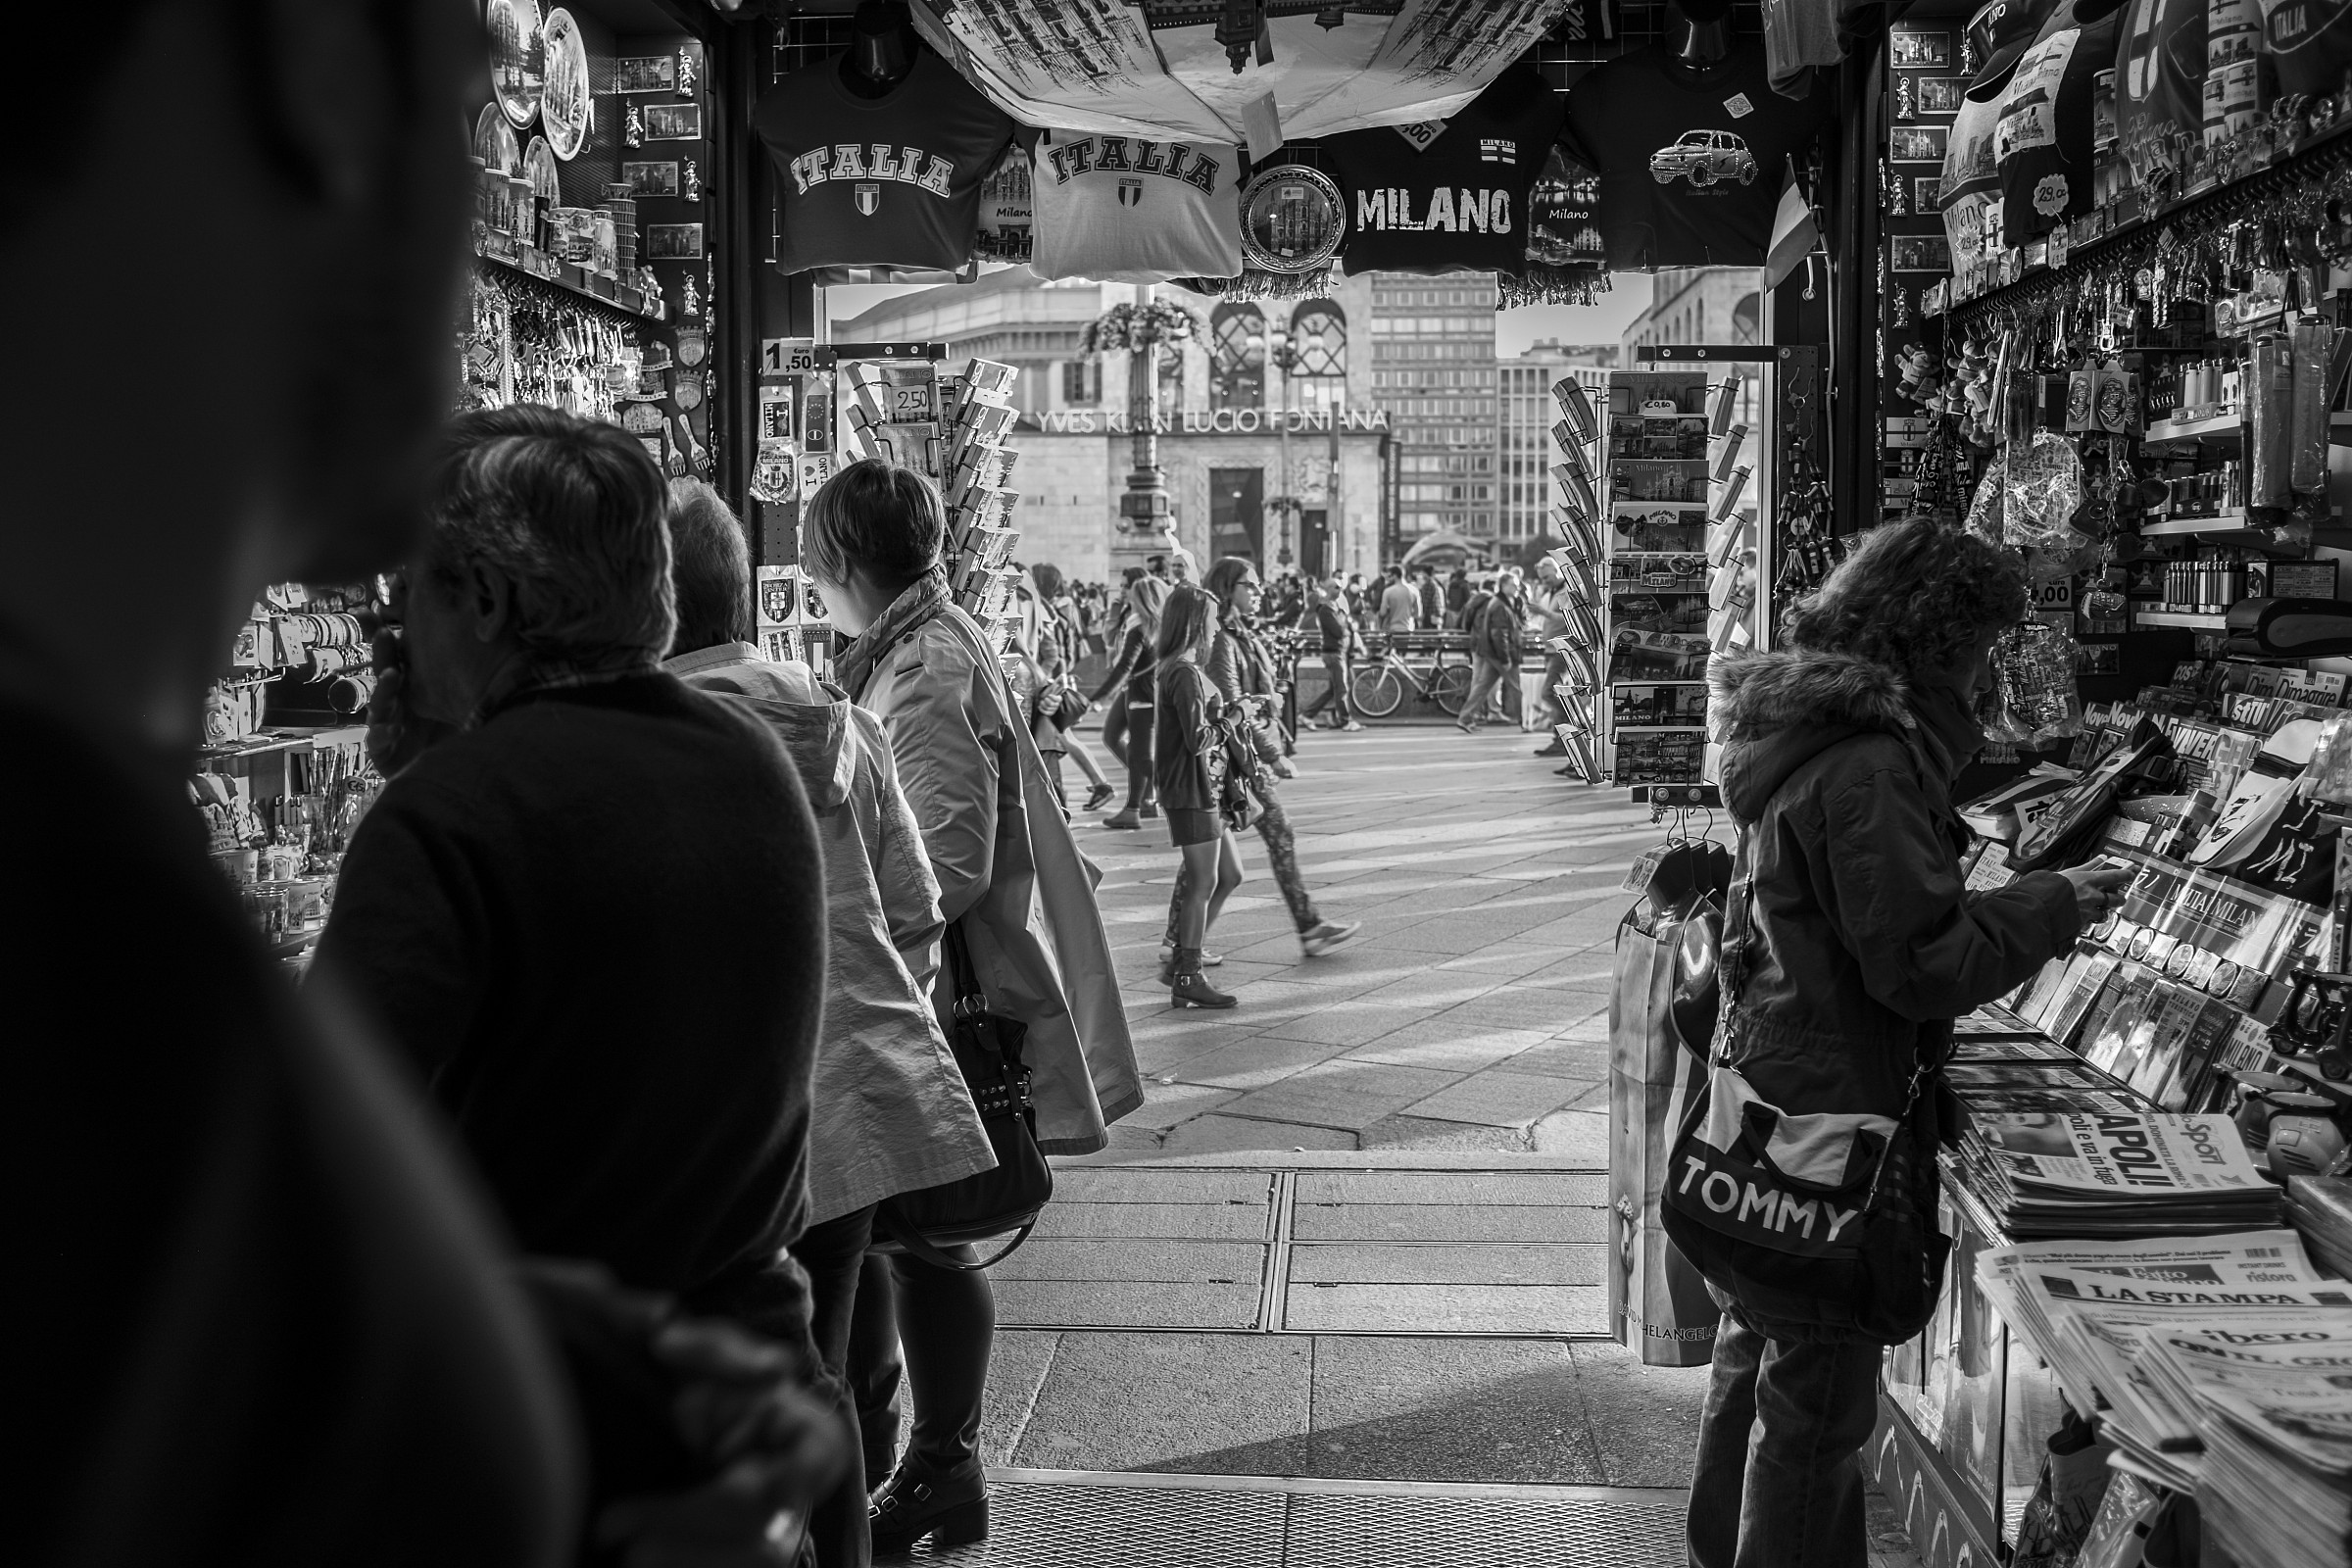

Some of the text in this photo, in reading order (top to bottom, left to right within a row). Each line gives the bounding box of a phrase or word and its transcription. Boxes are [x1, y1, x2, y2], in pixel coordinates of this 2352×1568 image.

[2274, 4, 2307, 41] ITALIA
[1401, 123, 1431, 143] ,00
[1481, 139, 1515, 148] MILANO
[791, 144, 955, 198] ITALIA
[1048, 136, 1221, 196] ITALIA
[996, 207, 1032, 218] Milano
[1357, 187, 1511, 234] MILANO
[1548, 209, 1589, 220] Milano
[898, 390, 928, 411] 2,50
[764, 403, 774, 437] MILANO
[1036, 408, 1391, 433] YVES KLN LUCIO FONTANA
[1649, 510, 1677, 520] MILANO
[1642, 574, 1676, 586] MILANO
[2281, 678, 2337, 709] Dimagrire
[2172, 993, 2201, 1012] MILANO
[2221, 1037, 2264, 1072] MILANO
[2080, 1143, 2098, 1154] va
[2086, 1155, 2106, 1164] in
[2093, 1167, 2119, 1185] fuga
[1679, 1154, 1858, 1242] TOMMY
[2246, 1271, 2298, 1283] ristora
[2087, 1284, 2305, 1304] LA STAMPA
[2200, 1330, 2331, 1344] ibero
